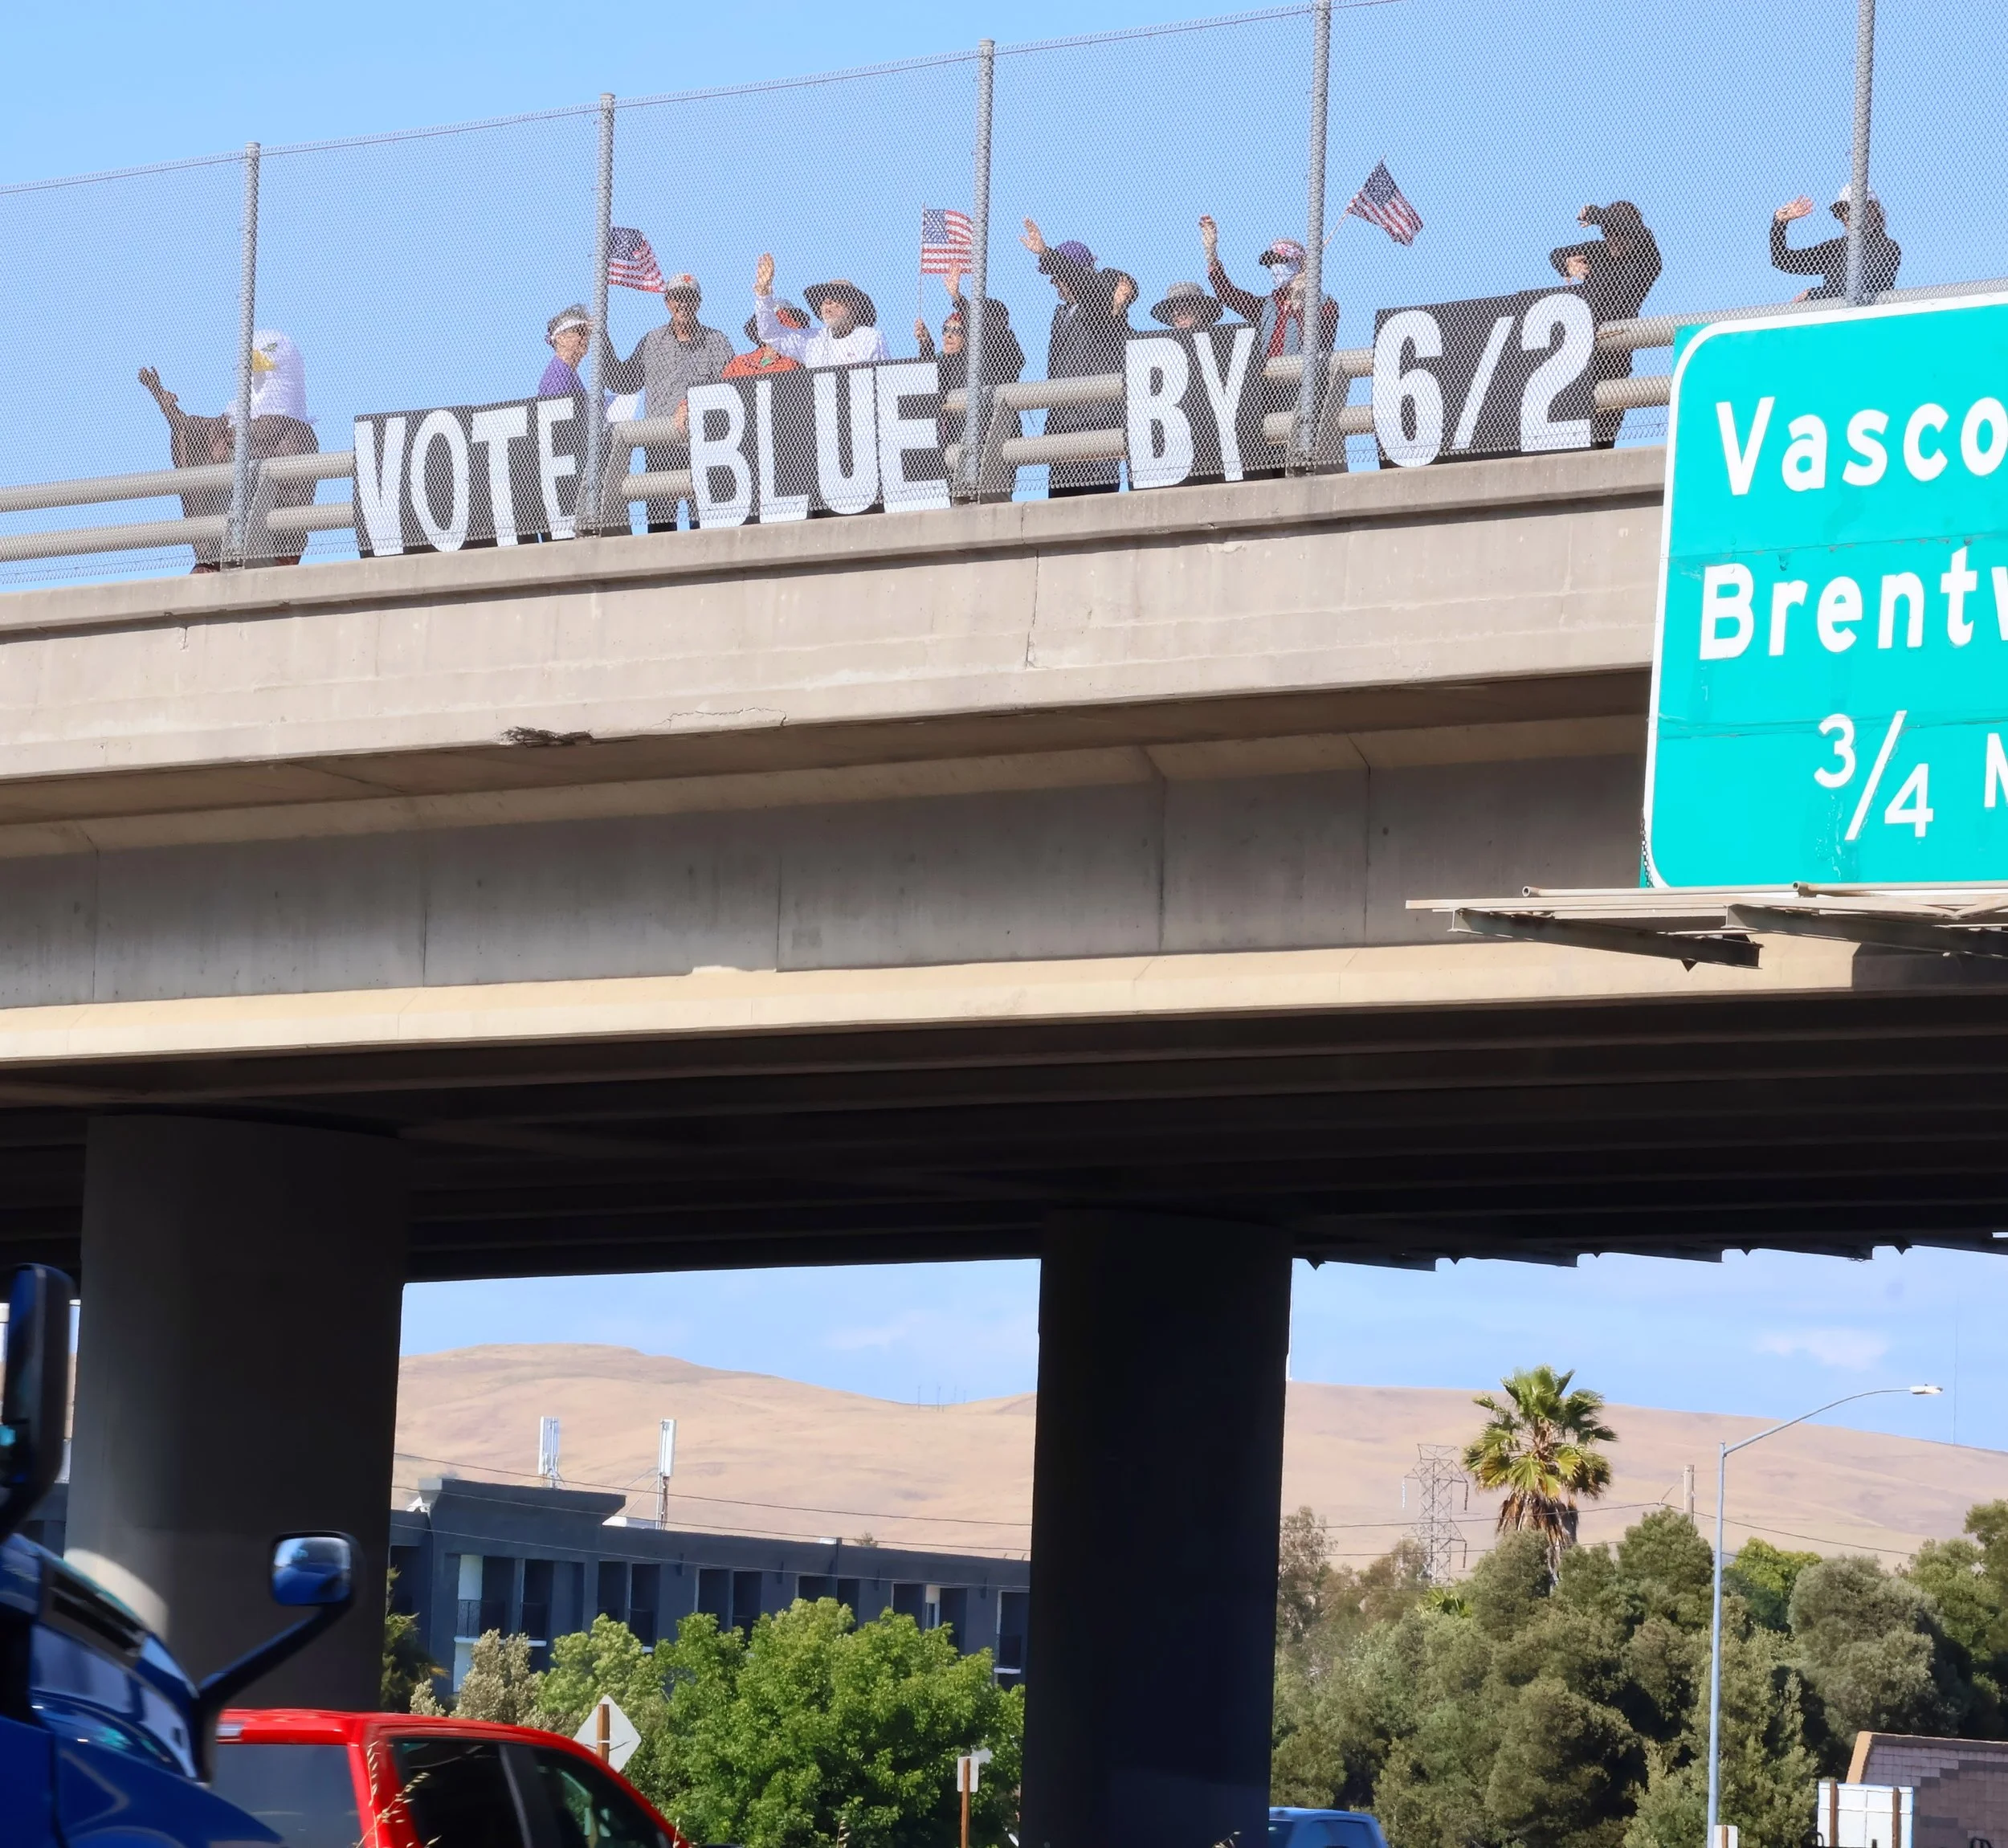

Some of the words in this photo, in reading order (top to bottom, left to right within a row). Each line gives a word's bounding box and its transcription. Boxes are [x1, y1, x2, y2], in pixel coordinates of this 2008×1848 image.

[355, 397, 578, 557] VOTE
[688, 362, 952, 528] BLUE
[1126, 328, 1255, 489] BY
[1372, 293, 1594, 468] 6/2
[1716, 396, 2008, 496] Vasco
[1699, 545, 2008, 661] Brent
[1814, 710, 1934, 841] 3/4
